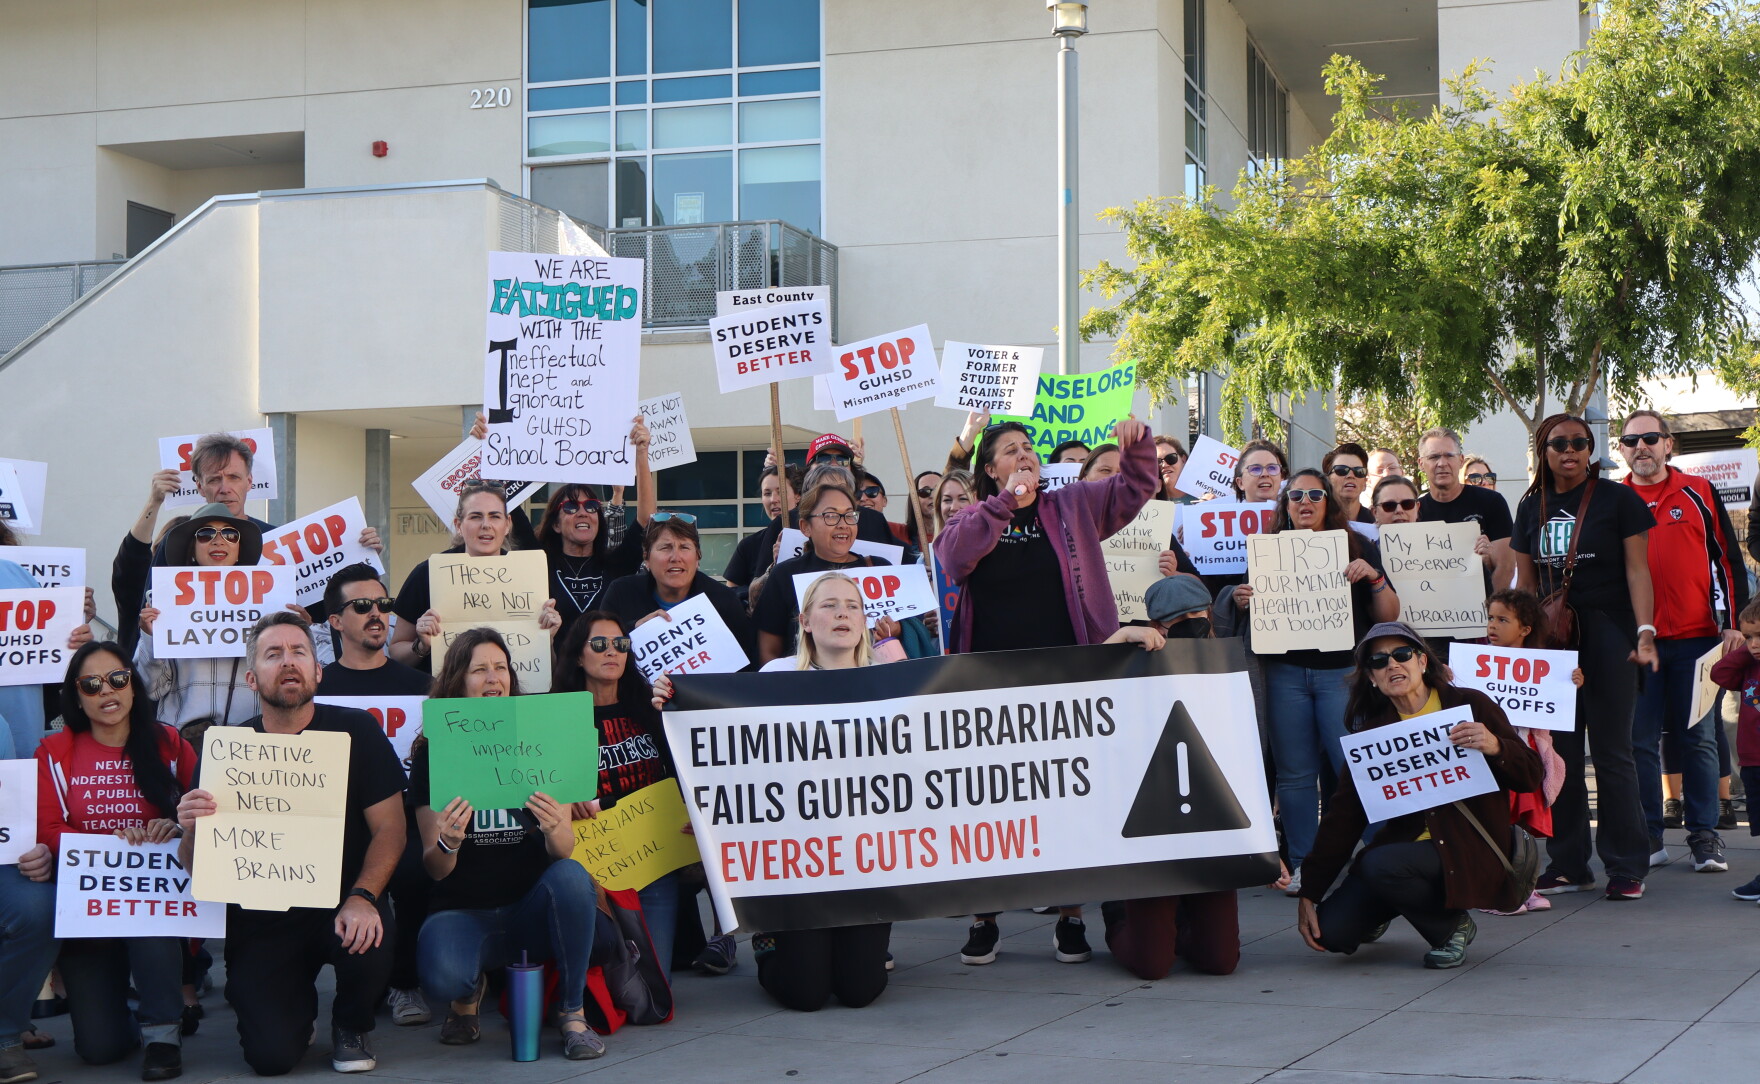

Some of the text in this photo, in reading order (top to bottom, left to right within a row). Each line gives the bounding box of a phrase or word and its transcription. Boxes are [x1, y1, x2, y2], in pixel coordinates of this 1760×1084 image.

[470, 87, 512, 109] 220
[534, 259, 611, 280] WE ARE
[490, 277, 638, 321] FATIGUED
[732, 295, 762, 306] East
[520, 320, 603, 340] WITH THE
[716, 312, 823, 342] STUDENTS
[729, 331, 815, 358] DESERVE
[968, 348, 1020, 361] VOTER &
[737, 350, 813, 375] BETTER
[839, 337, 916, 381] STOP
[965, 361, 1017, 373] FORMER
[571, 375, 593, 387] and
[859, 369, 913, 391] GUHSD
[960, 373, 1019, 386] STUDENT
[1035, 365, 1134, 400] NSELORS
[843, 378, 936, 409] Mismanagement
[959, 385, 1015, 398] AGAINST
[639, 397, 681, 416] RE NOT
[958, 397, 1012, 411] LAYOFFS
[1029, 402, 1085, 424] AND
[526, 416, 592, 437] GUHSD
[1026, 418, 1117, 449] RARIANS
[487, 433, 629, 466] School Board
[649, 431, 677, 446] CIND
[648, 445, 684, 463] YOFFS!
[1216, 452, 1239, 469] ST
[1208, 470, 1235, 489] GUH
[1200, 509, 1275, 538] STOP
[262, 514, 346, 565] STOP
[1213, 540, 1247, 551] GUH
[1384, 533, 1412, 555] My
[1194, 555, 1248, 564] Mismana
[1252, 536, 1345, 573] FIRST
[296, 551, 344, 582] UHSD
[174, 570, 274, 606] STOP
[853, 575, 901, 600] OP
[1254, 575, 1293, 594] OUR
[1420, 580, 1437, 592] a
[501, 591, 535, 610] NOT
[864, 600, 896, 611] HSD
[866, 604, 918, 618] OFFS
[0, 600, 56, 632] TOP
[190, 609, 262, 623] GUHSD
[0, 634, 43, 647] UHSD
[634, 613, 706, 662] UDENTS
[642, 632, 708, 678] ESERVE
[1475, 654, 1551, 685] STOP
[1486, 682, 1539, 697] GUHSD
[1494, 695, 1556, 714] YOFFS
[444, 710, 504, 733] Fear
[690, 696, 1116, 768] ELIMINATING LIBRARIANS
[471, 740, 544, 762] impedes
[1349, 720, 1468, 764] STUDENT
[1366, 744, 1468, 782] DESERVE
[71, 774, 135, 786] NDERESTI
[225, 767, 327, 789] SOLUTIONS
[494, 767, 564, 787] LOGIC
[1381, 765, 1472, 801] BETTER
[83, 789, 145, 799] A PUBLIC
[236, 791, 292, 813] NEED
[693, 781, 785, 826] FAILS
[797, 772, 913, 821] GUHSD
[924, 756, 1091, 810] STUDENTS
[86, 803, 143, 815] SCHOOL
[212, 827, 286, 850] MORE
[720, 815, 1041, 882] EVERSE CUTS NOW!
[66, 849, 184, 870] STUDEN
[585, 837, 620, 865] ARE
[233, 856, 316, 884] BRAINS
[592, 840, 665, 885] SENTIAL
[79, 875, 190, 893] DESERV
[87, 899, 198, 917] BETTER
